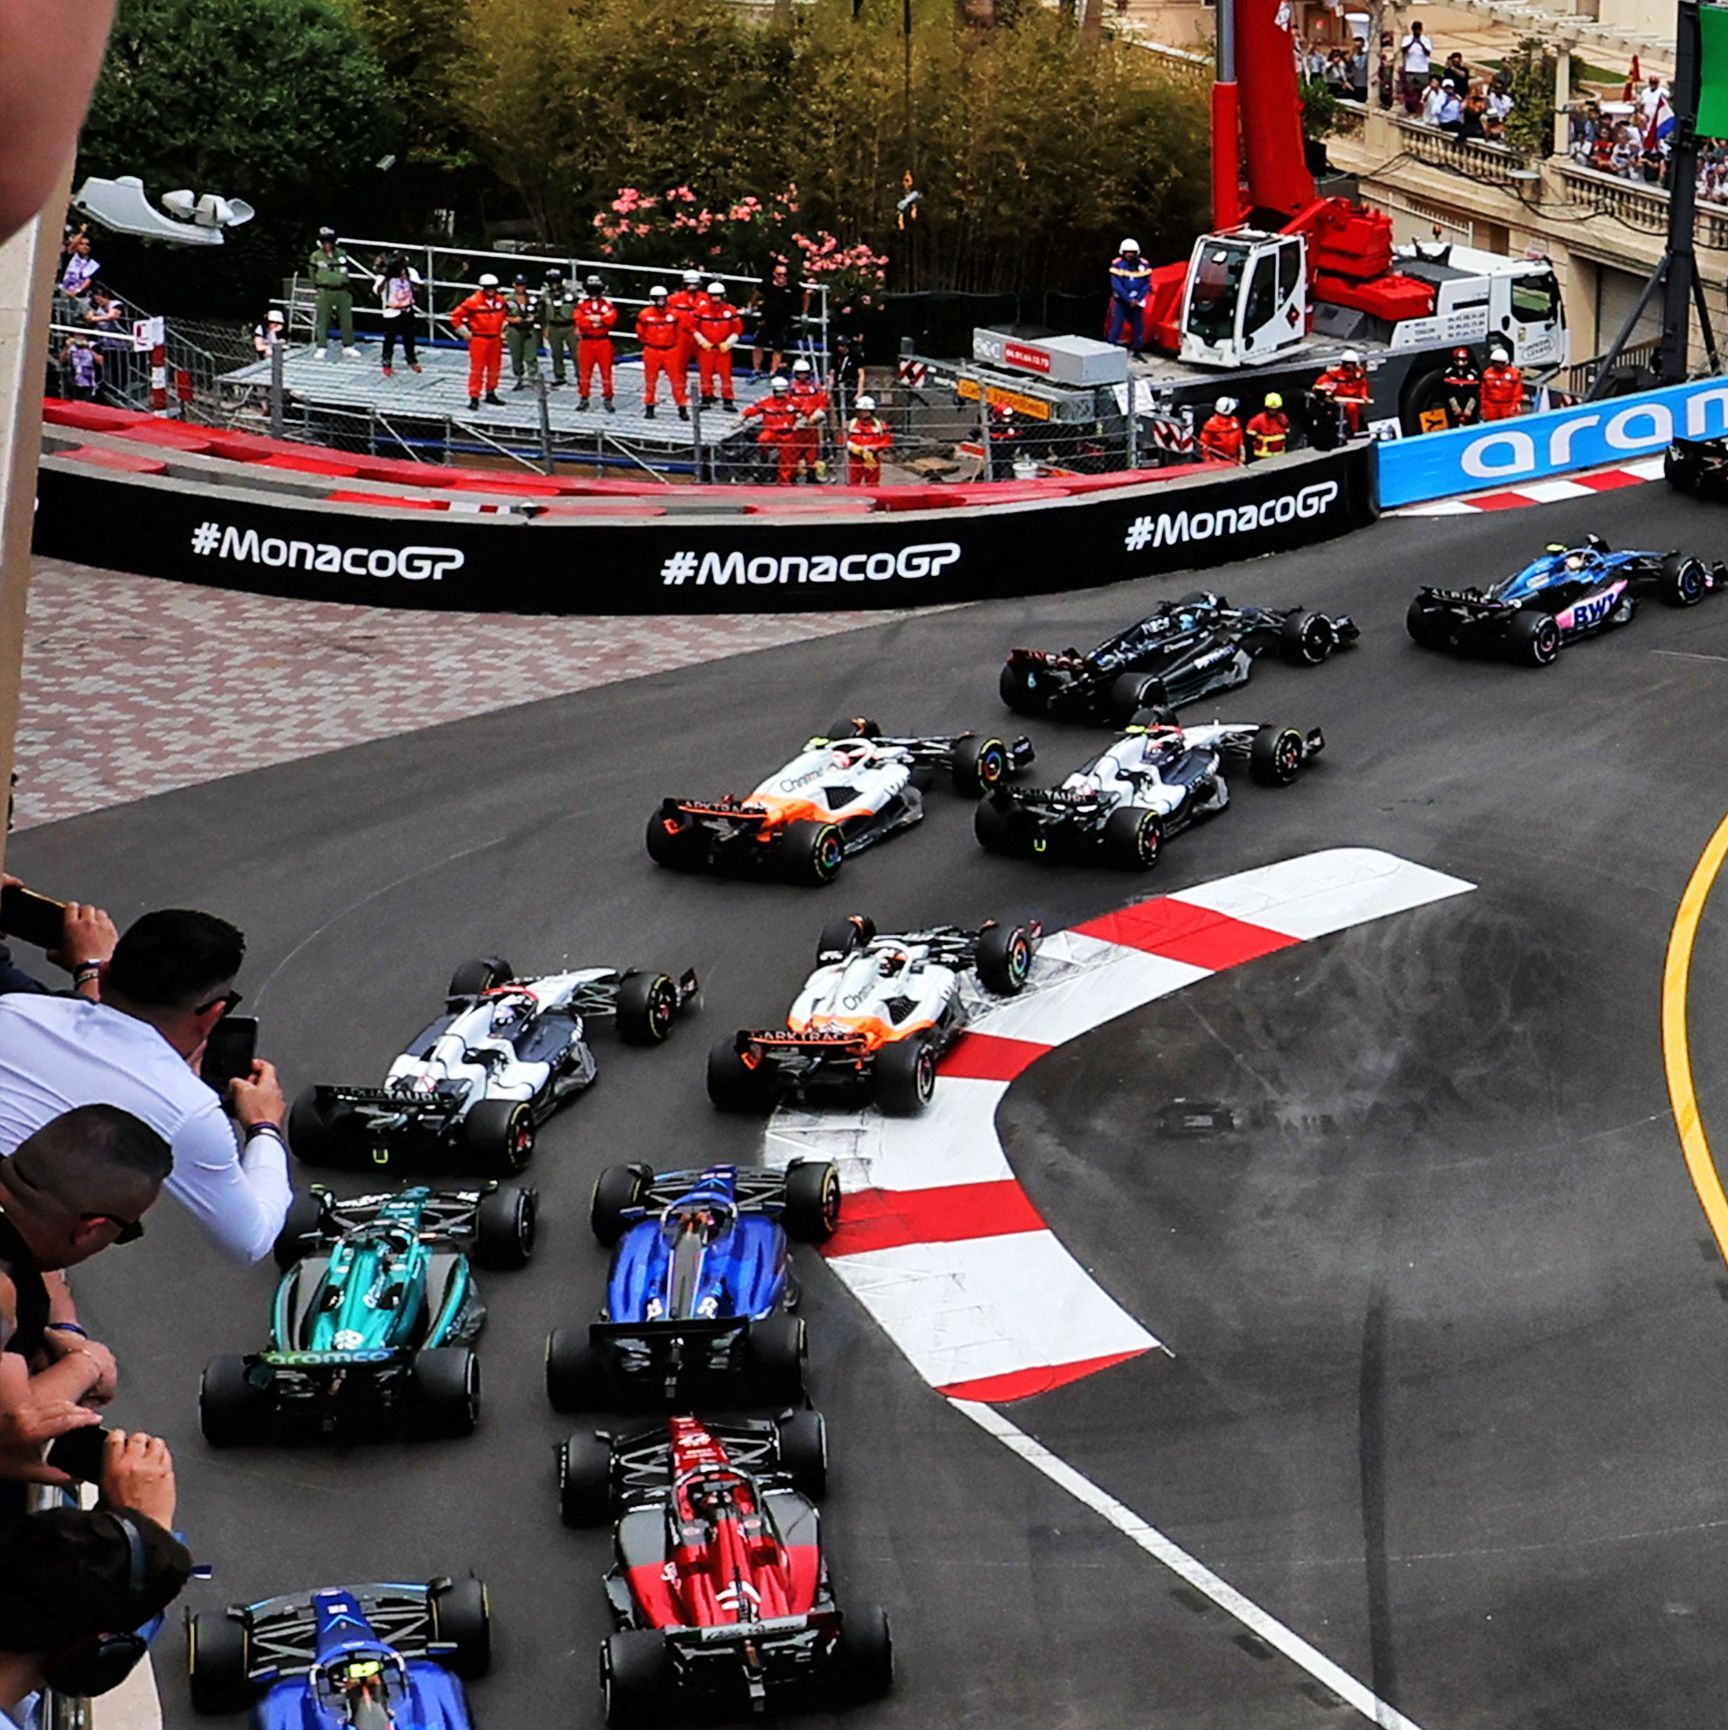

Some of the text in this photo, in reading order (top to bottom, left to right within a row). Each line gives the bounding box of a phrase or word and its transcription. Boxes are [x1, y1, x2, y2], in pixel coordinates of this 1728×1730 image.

[1125, 480, 1338, 552] #MonacoGP
[191, 521, 465, 580] #MonacoGP
[660, 542, 962, 585] #MonacoGP
[1572, 591, 1620, 625] BWT
[266, 1349, 392, 1366] aramco
